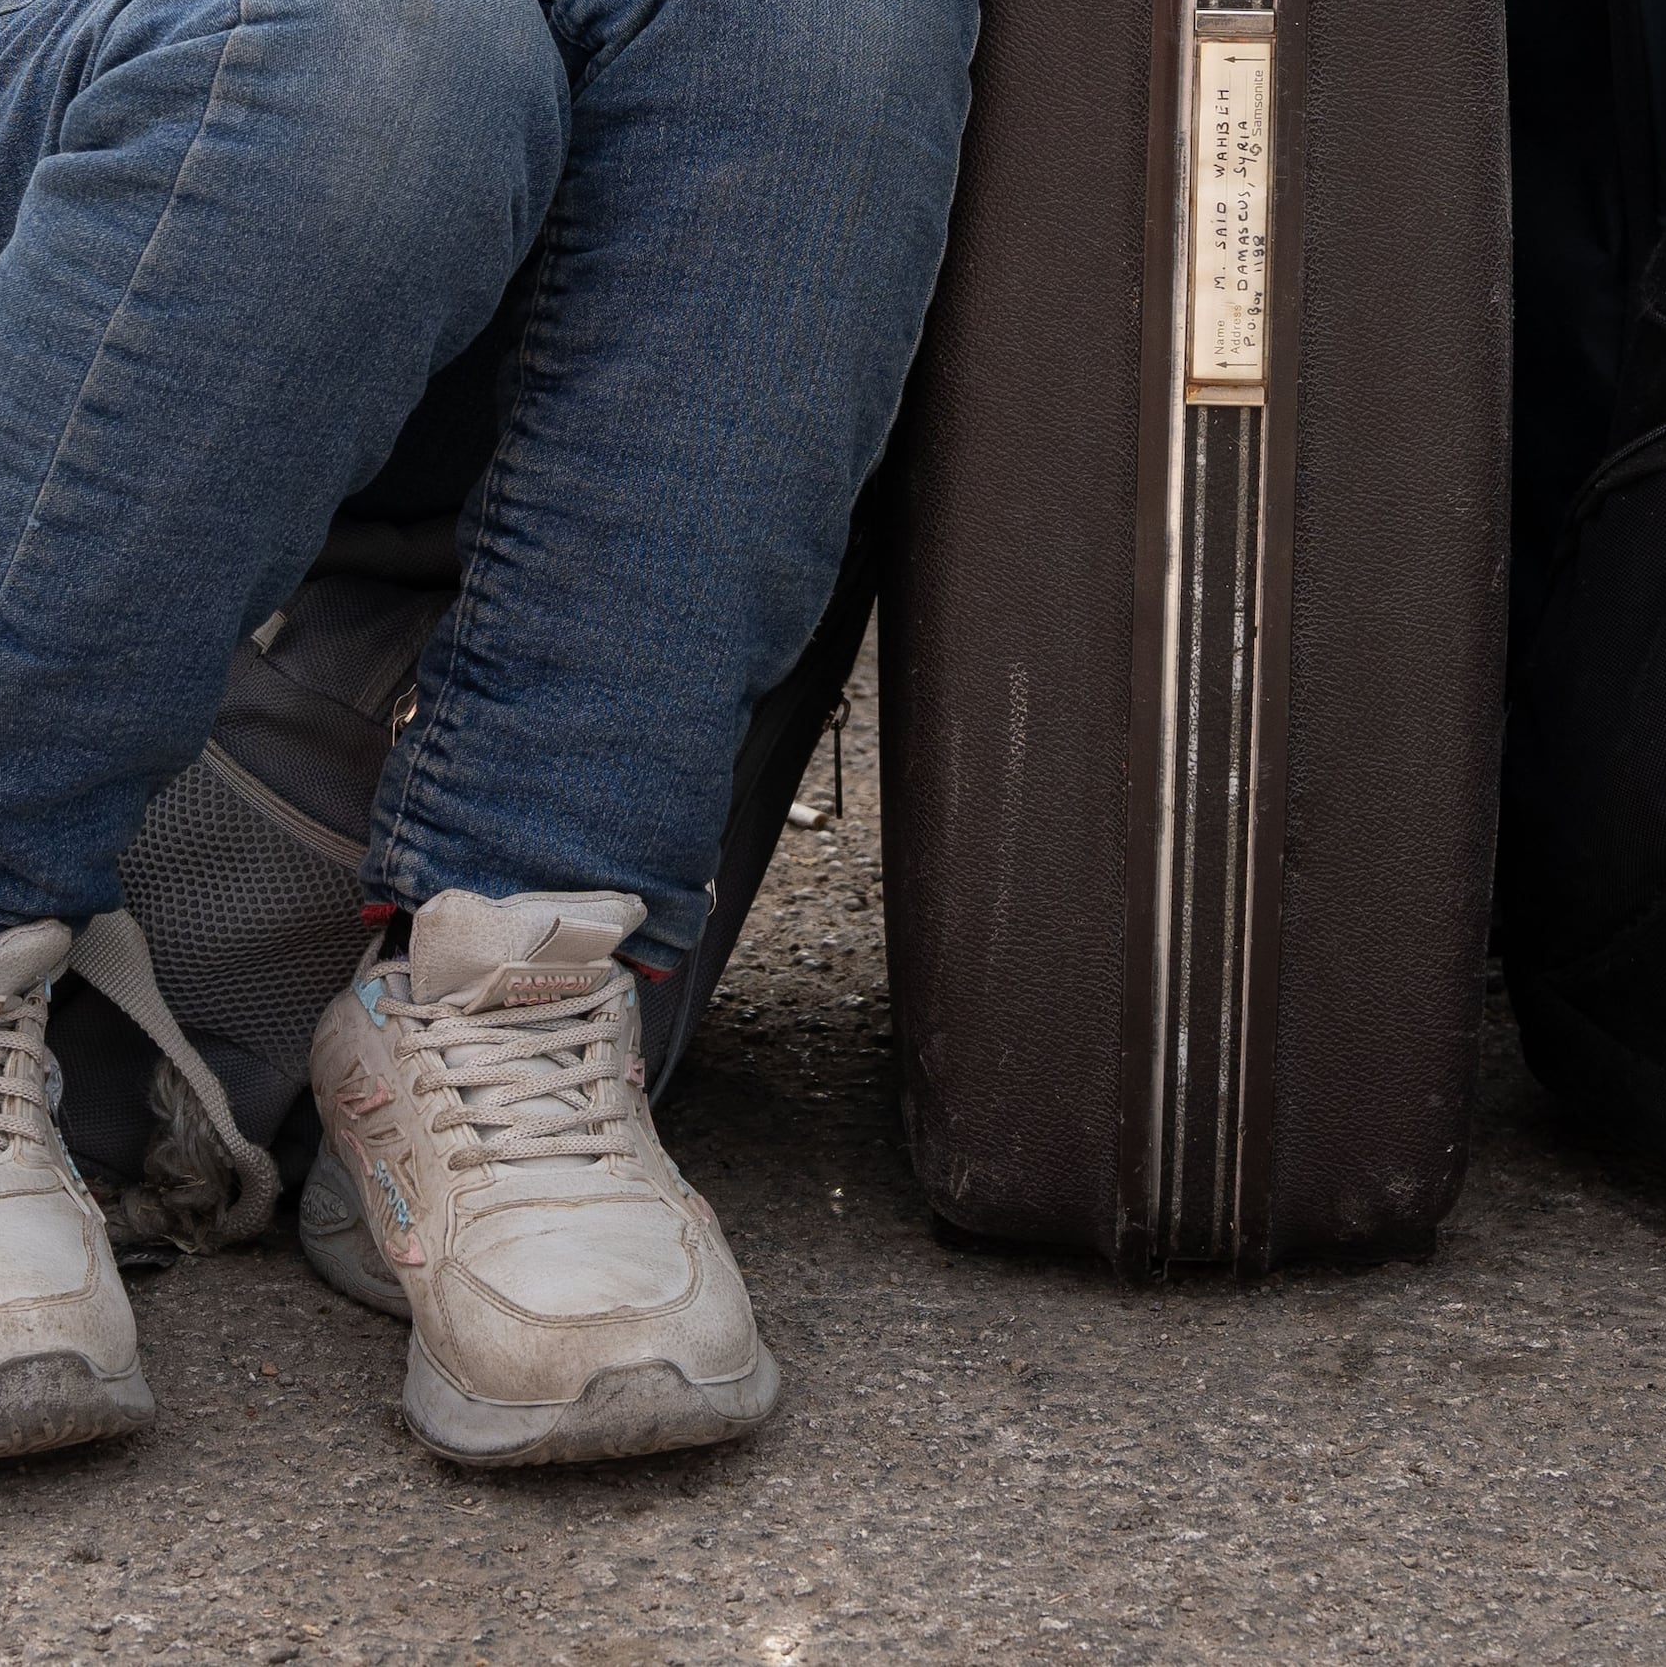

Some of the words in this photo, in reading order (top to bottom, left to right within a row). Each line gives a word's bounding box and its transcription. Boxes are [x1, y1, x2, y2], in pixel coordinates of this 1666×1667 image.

[1252, 69, 1264, 137] Samsonite
[1233, 120, 1257, 179] SYRIA
[1214, 319, 1226, 355] Name
[1230, 304, 1243, 355] Address
